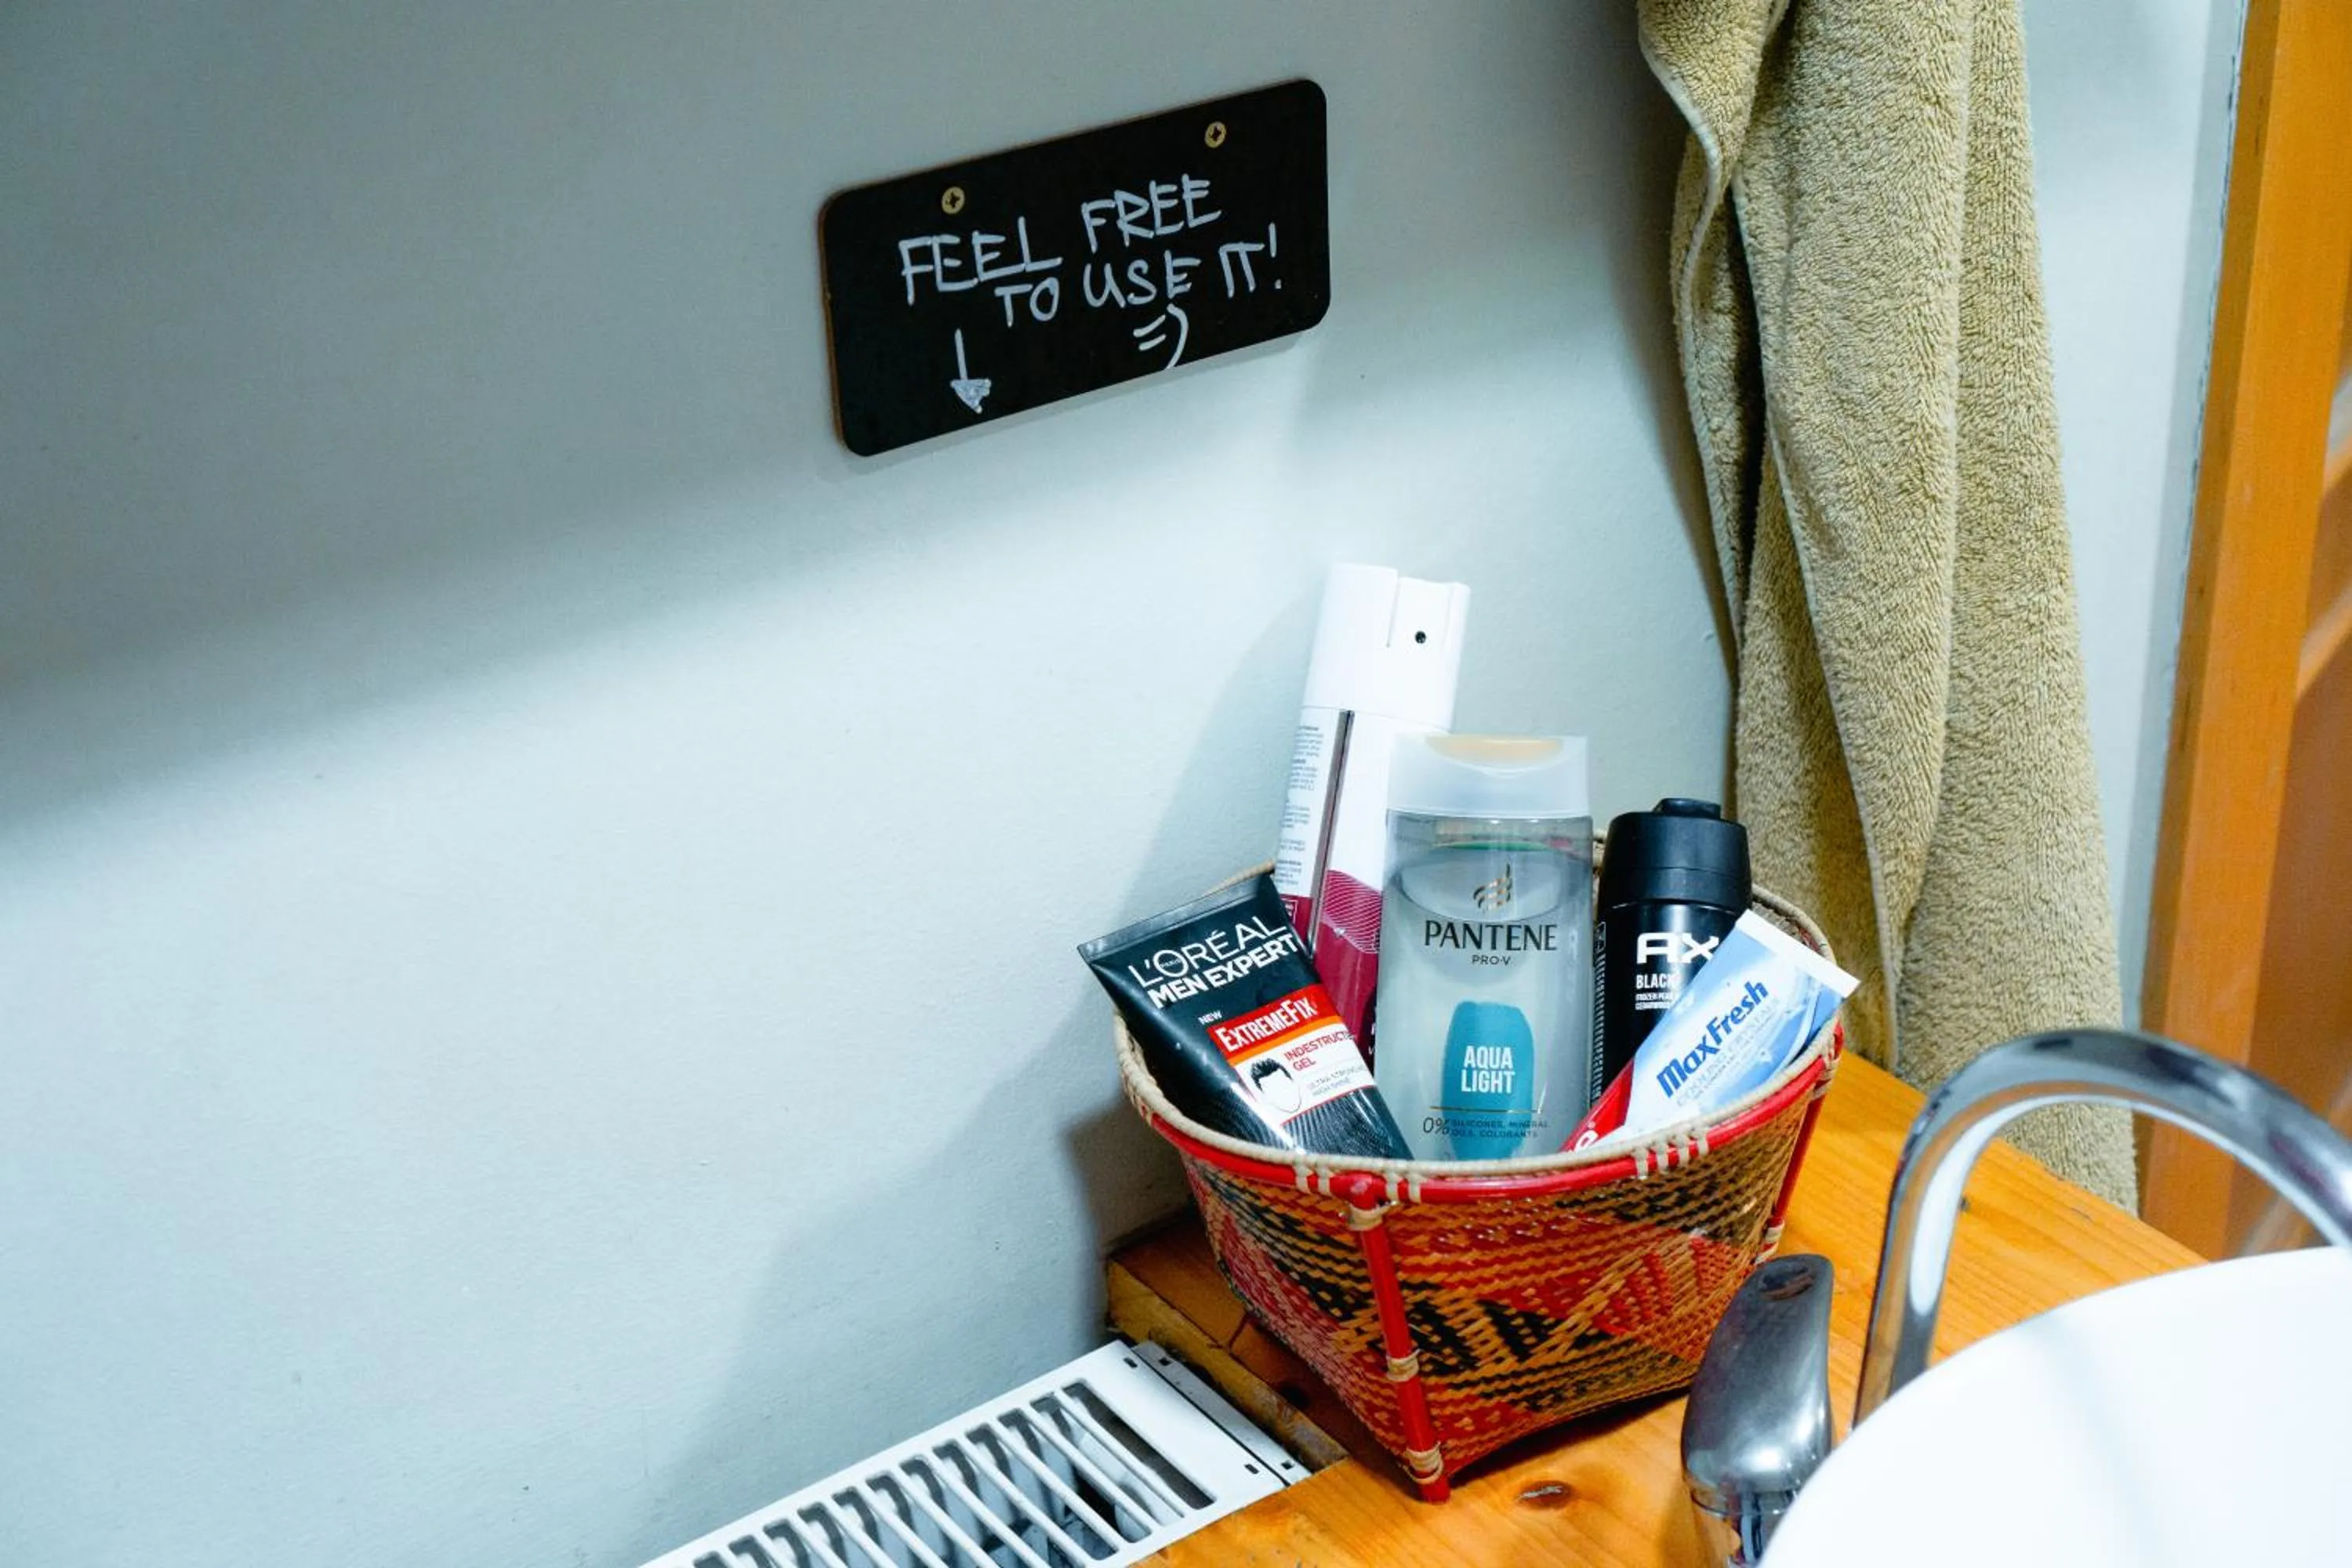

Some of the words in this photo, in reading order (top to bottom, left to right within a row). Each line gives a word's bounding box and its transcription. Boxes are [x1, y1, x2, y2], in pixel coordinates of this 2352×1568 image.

[898, 216, 1063, 307] FEEL
[1081, 173, 1221, 253] FREE
[994, 276, 1059, 328] TO
[1083, 250, 1202, 309] USE
[1218, 222, 1283, 298] IT!
[1127, 916, 1288, 988] L'ORÉAL
[1424, 920, 1557, 952] PANTENE
[1147, 974, 1210, 1010] MEN
[1203, 932, 1298, 988] EXPERT
[1198, 1010, 1223, 1025] NEW
[1656, 979, 1769, 1098] MaxFresh
[1292, 1056, 1317, 1072] GEL
[1461, 1069, 1515, 1094] LIGHT
[1463, 1045, 1514, 1070] AQUA
